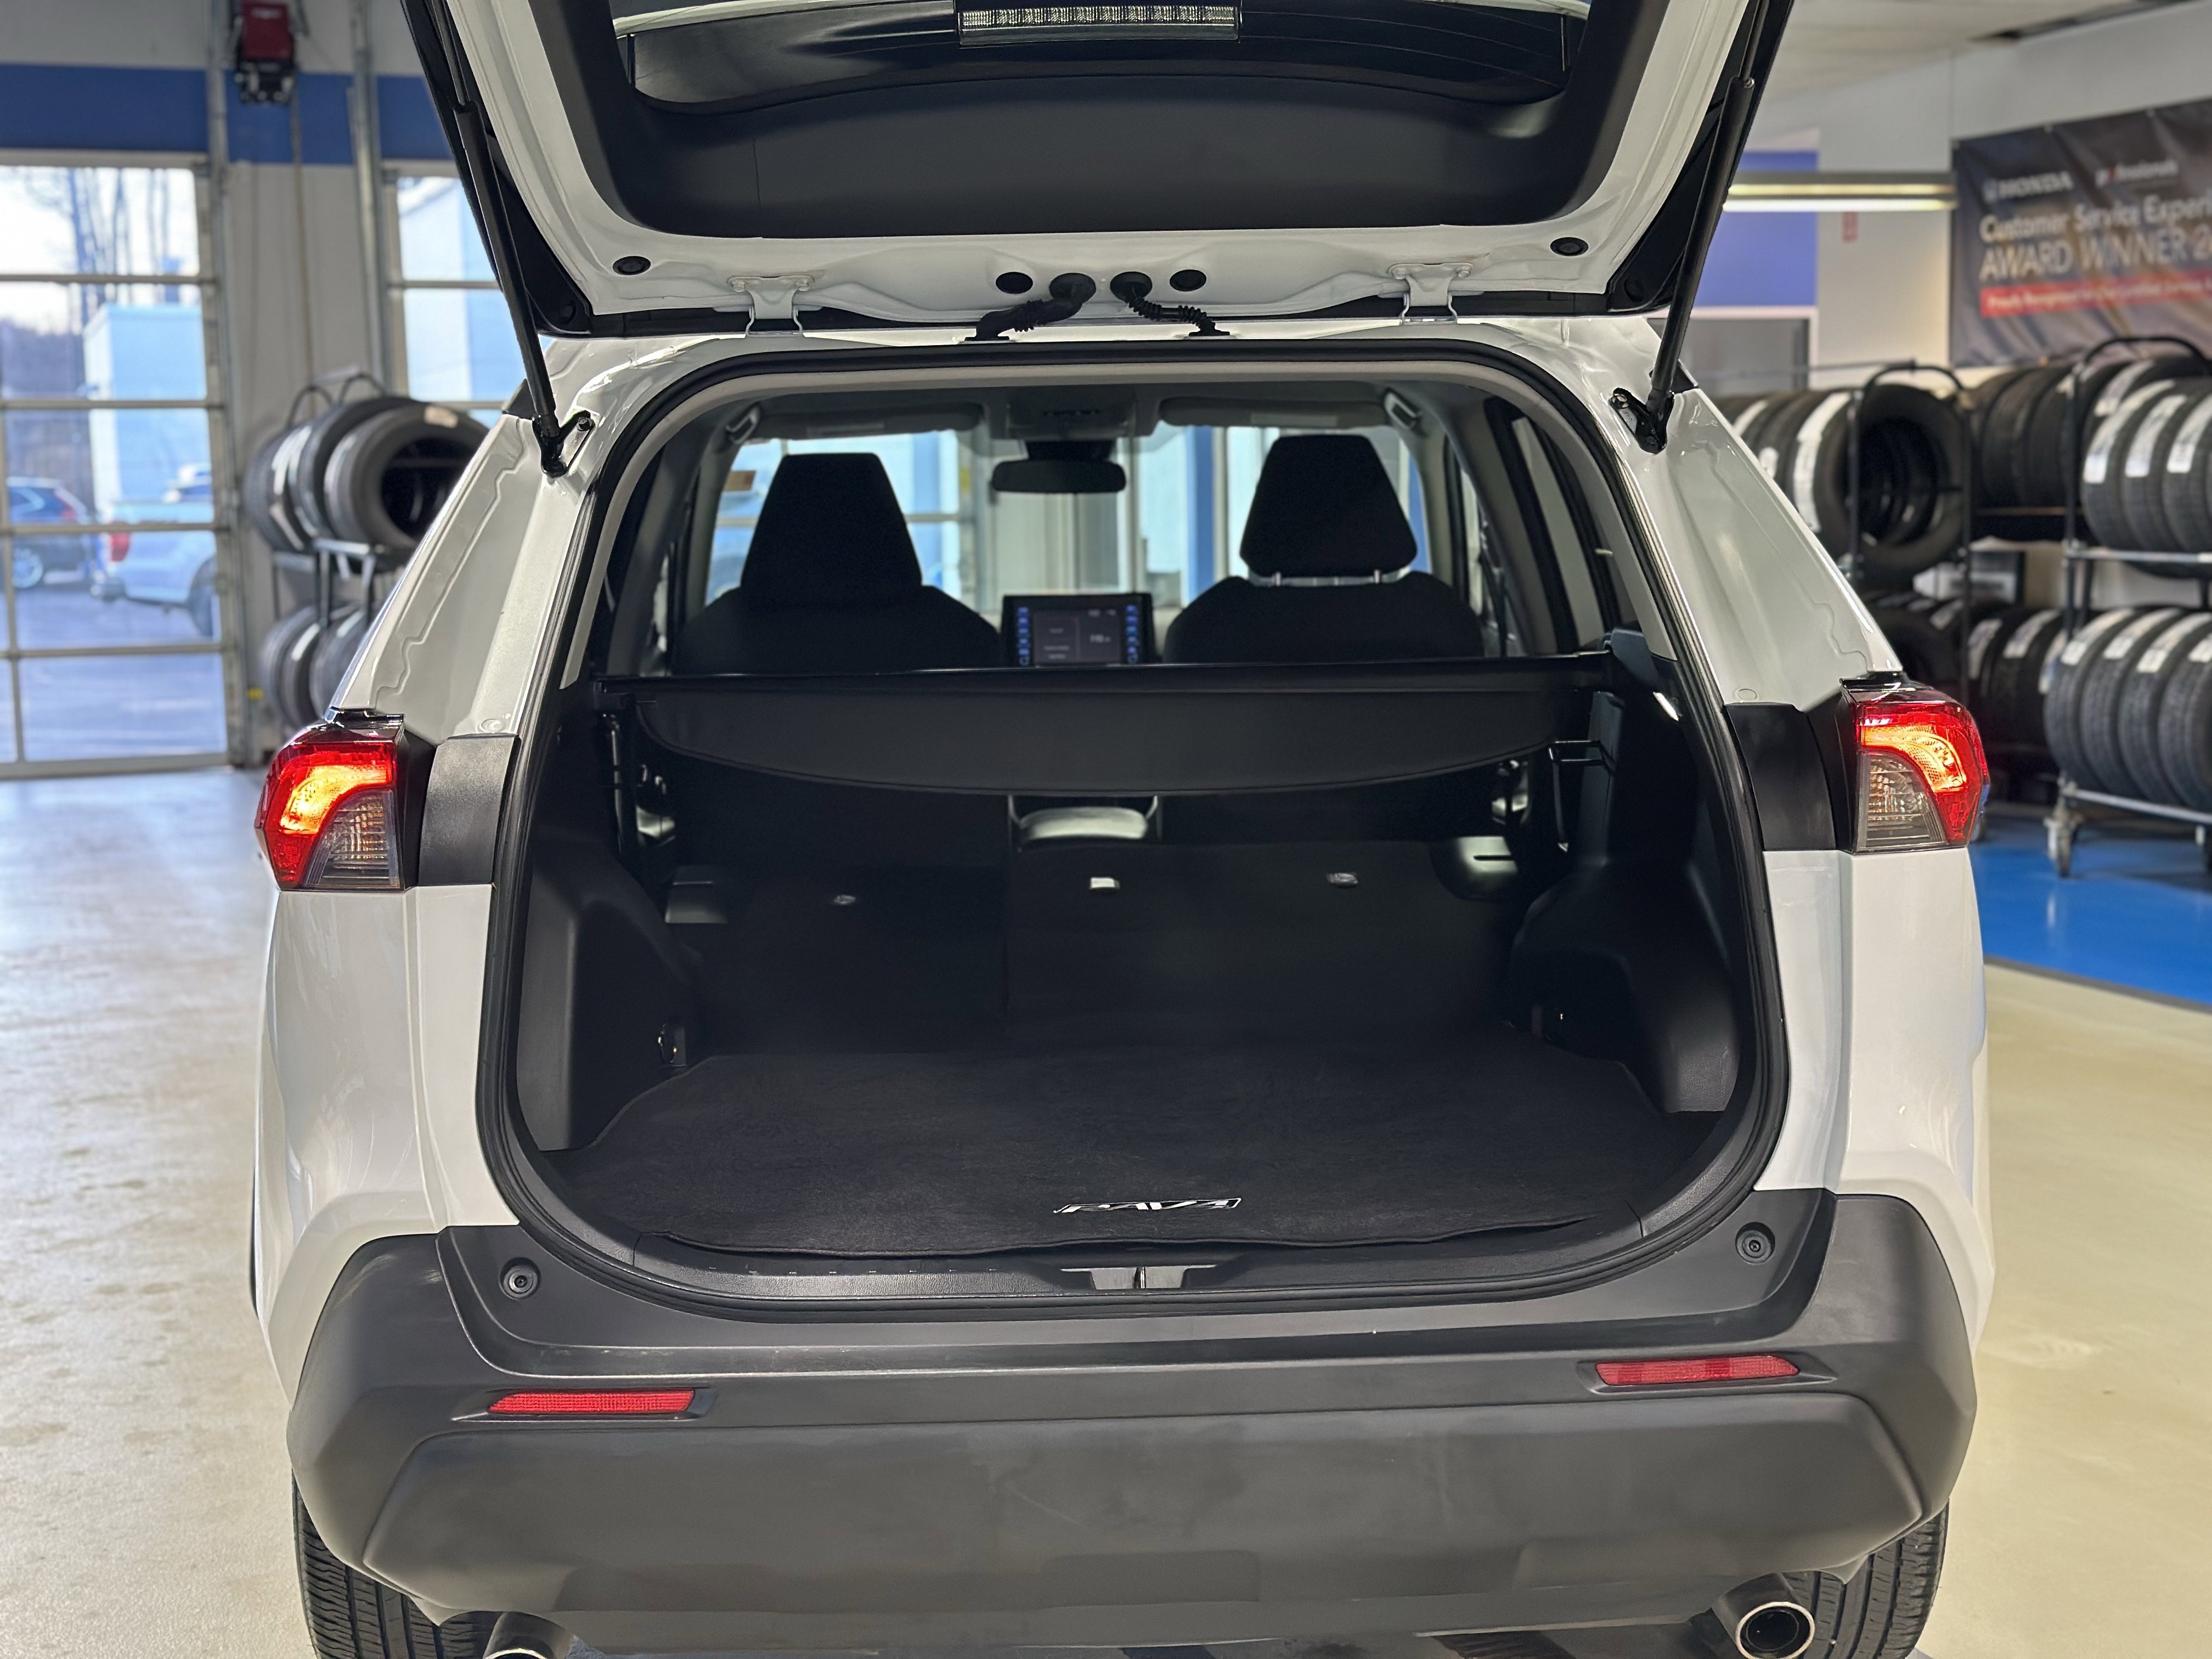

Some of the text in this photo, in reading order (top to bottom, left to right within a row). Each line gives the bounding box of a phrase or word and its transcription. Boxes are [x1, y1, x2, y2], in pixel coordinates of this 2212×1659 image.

[1999, 172, 2072, 198] HONDA
[1979, 214, 2069, 243] Customer
[2074, 203, 2139, 232] Service
[1980, 241, 2072, 280] AWARD
[2081, 229, 2187, 269] WINNER
